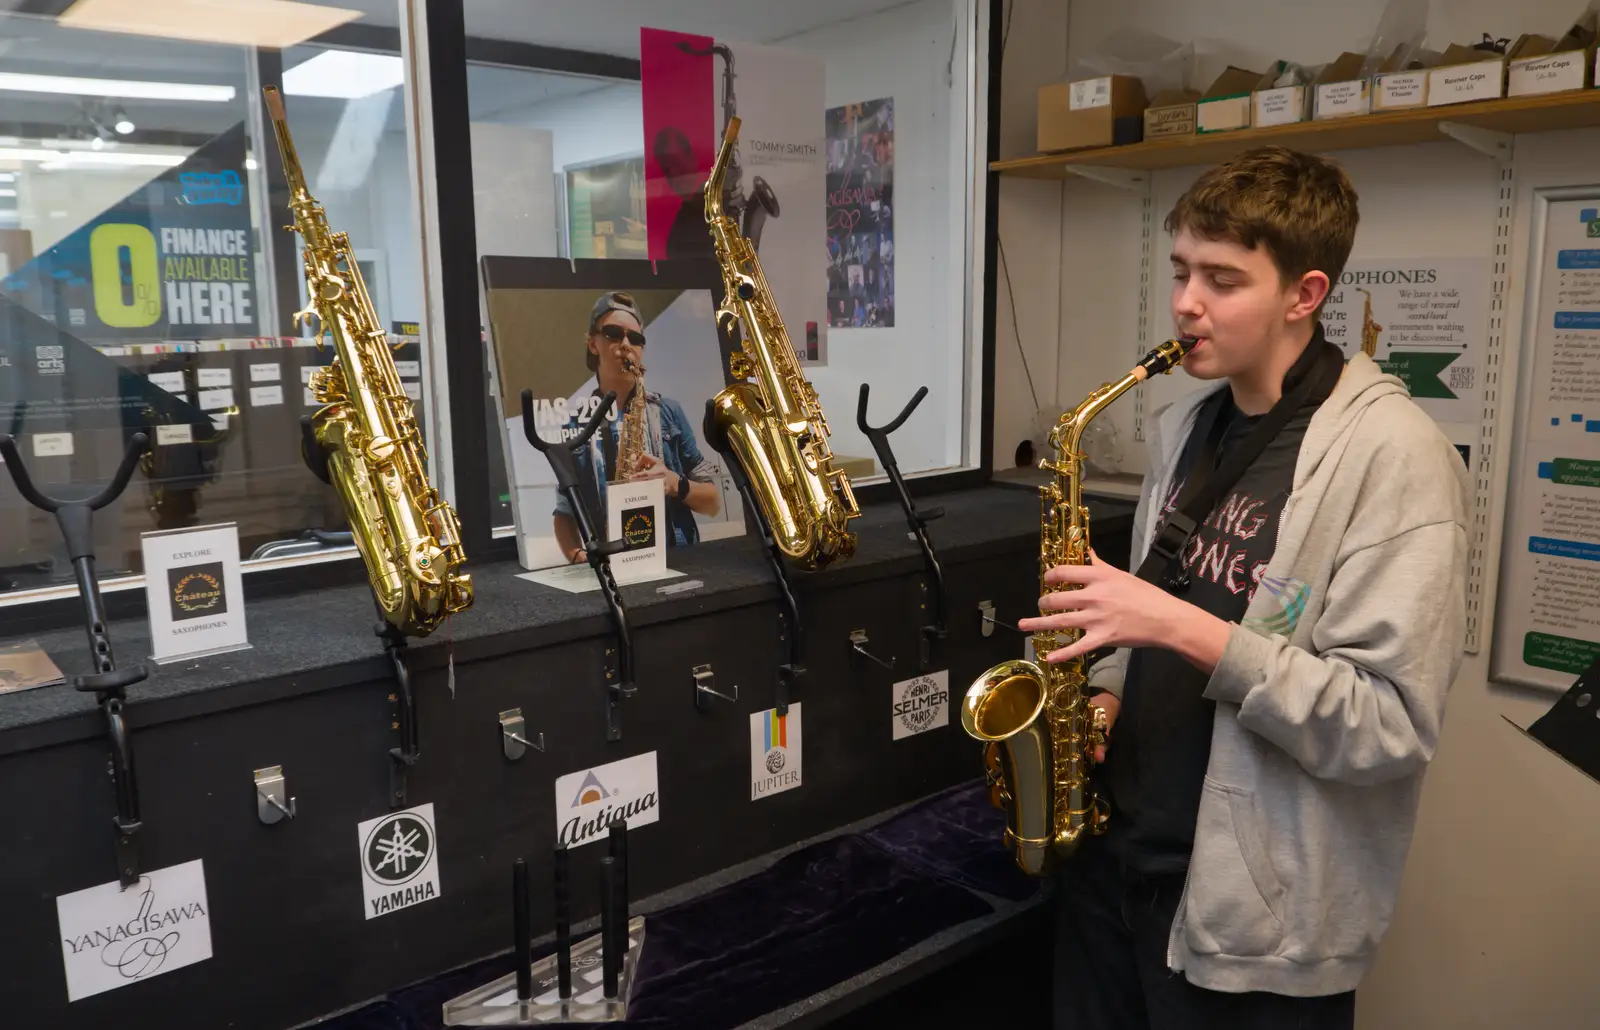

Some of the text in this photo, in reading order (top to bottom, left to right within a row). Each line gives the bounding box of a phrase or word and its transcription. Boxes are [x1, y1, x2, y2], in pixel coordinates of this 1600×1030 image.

[1524, 60, 1570, 72] Rovner Caps
[1444, 73, 1486, 85] Rovner Caps
[750, 140, 817, 156] TOMMY SMITH
[160, 227, 248, 256] FINANCE
[164, 256, 249, 282] AVAILABLE
[1337, 268, 1437, 286] OPHONES
[1325, 292, 1344, 304] nd
[1399, 289, 1411, 298] We
[1414, 289, 1432, 298] have
[1440, 288, 1459, 298] wide
[165, 281, 253, 325] HERE
[1397, 302, 1418, 311] range
[1420, 300, 1430, 309] of
[1320, 310, 1347, 321] ou're
[1326, 325, 1347, 338] for?
[1389, 322, 1465, 333] instruments waiting
[1389, 334, 1397, 342] to
[1399, 332, 1410, 342] be
[624, 495, 649, 504] EXPLORE
[172, 548, 213, 560] EXPLORE
[621, 552, 656, 564] SAXOPHONES
[174, 588, 221, 602] Château
[172, 619, 228, 636] SAXOPHONES
[911, 684, 930, 698] HENRI
[893, 690, 949, 717] SELMER
[910, 709, 931, 724] PARIS
[752, 770, 799, 799] JUPITER
[371, 880, 435, 916] YAMAHA
[64, 901, 206, 954] YANAGISAWA
